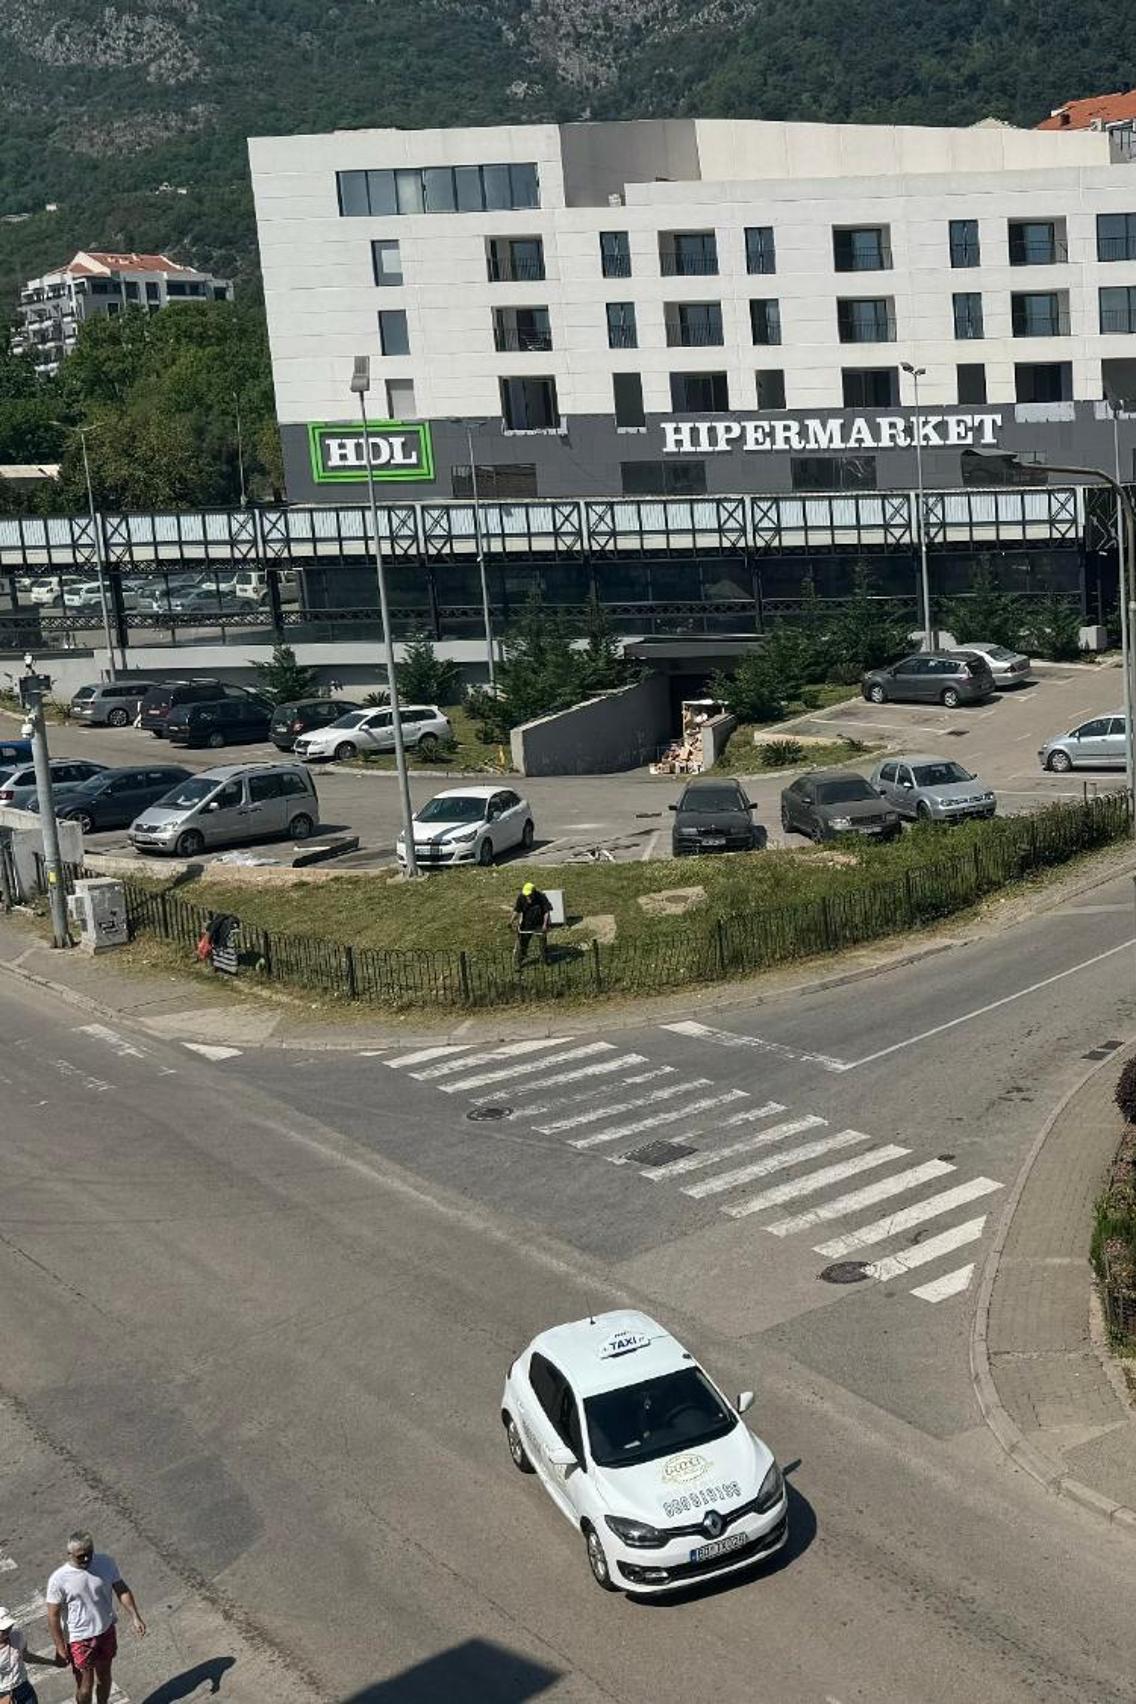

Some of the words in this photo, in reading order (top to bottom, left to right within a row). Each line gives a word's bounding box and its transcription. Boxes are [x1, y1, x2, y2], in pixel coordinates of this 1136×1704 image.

[660, 413, 1003, 453] HIPERMARKET
[326, 436, 419, 468] HDL
[608, 1335, 637, 1351] TAXI
